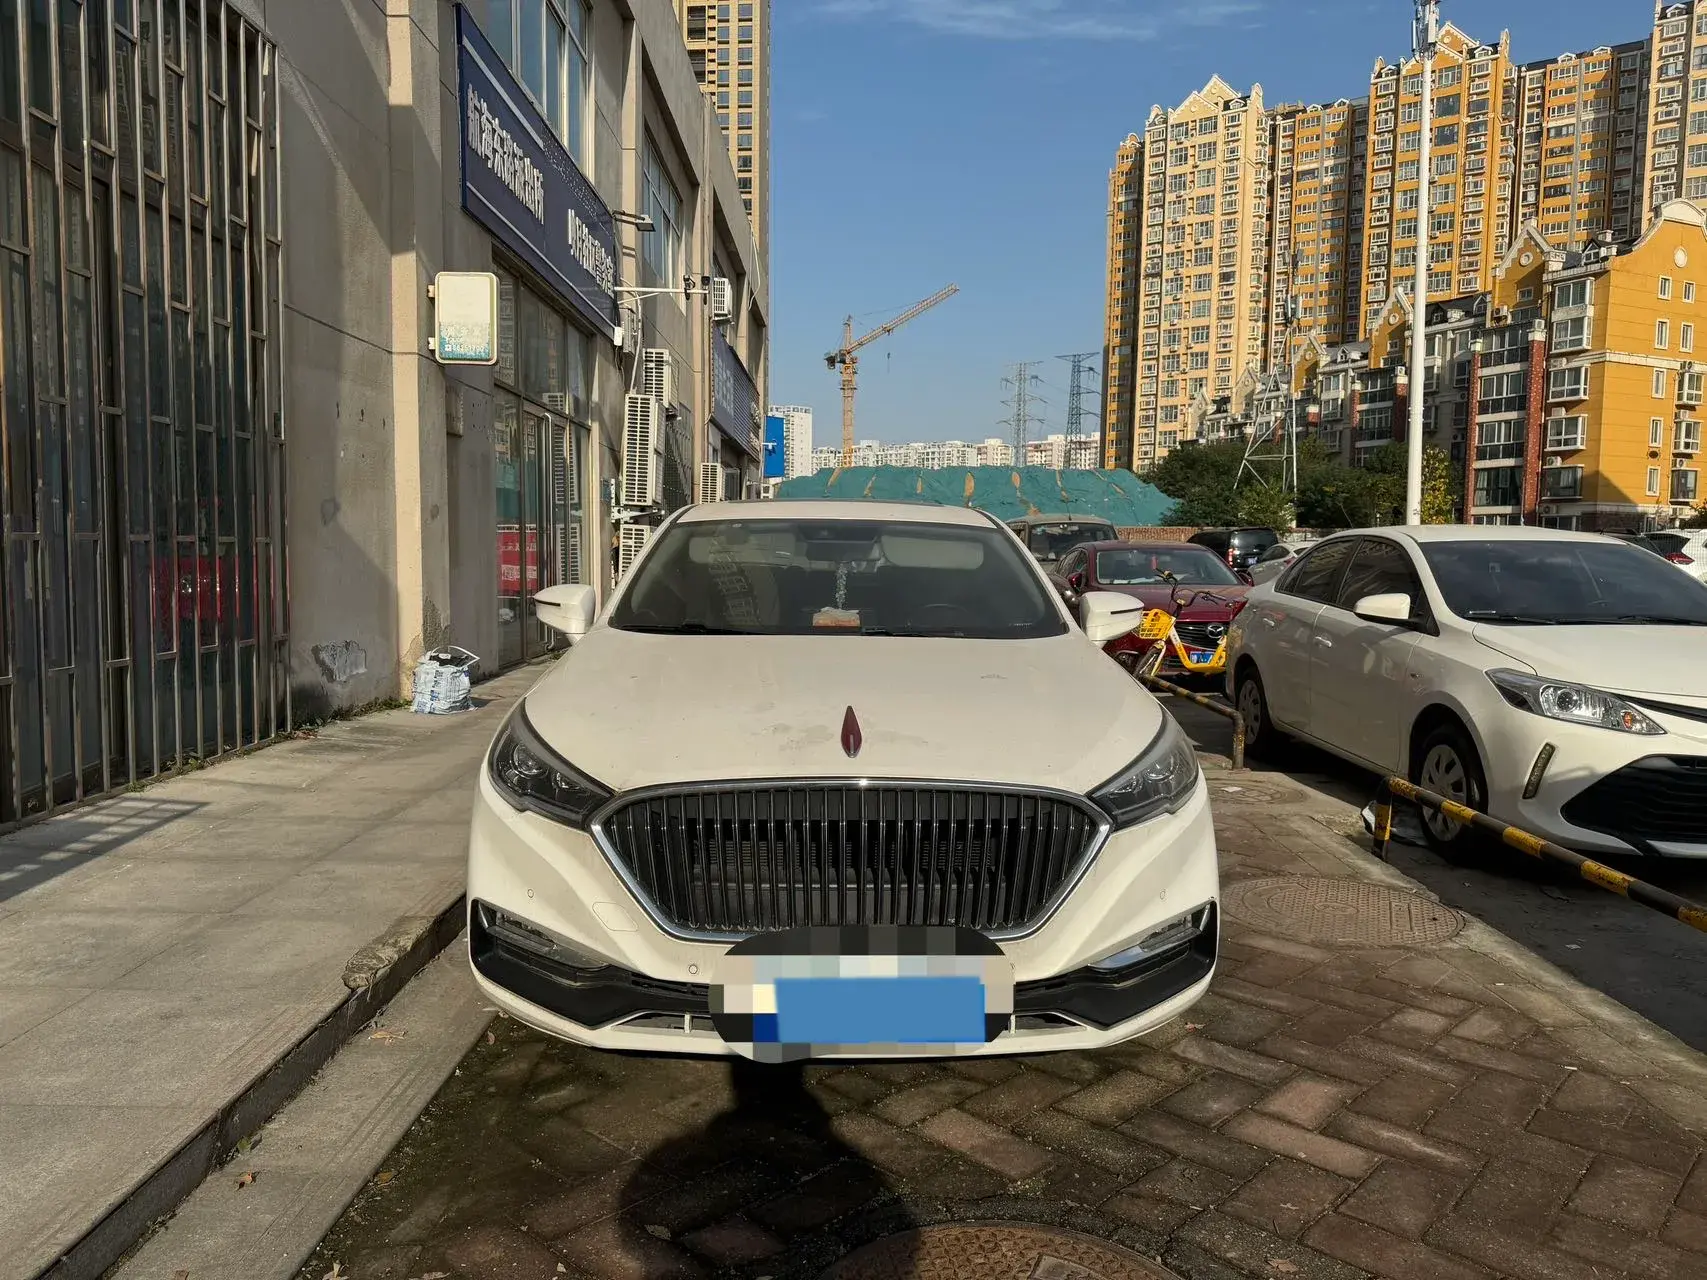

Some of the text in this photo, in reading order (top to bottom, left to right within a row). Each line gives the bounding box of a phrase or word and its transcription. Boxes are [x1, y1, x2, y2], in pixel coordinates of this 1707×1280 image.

[467, 83, 544, 225] 航海东路派出所
